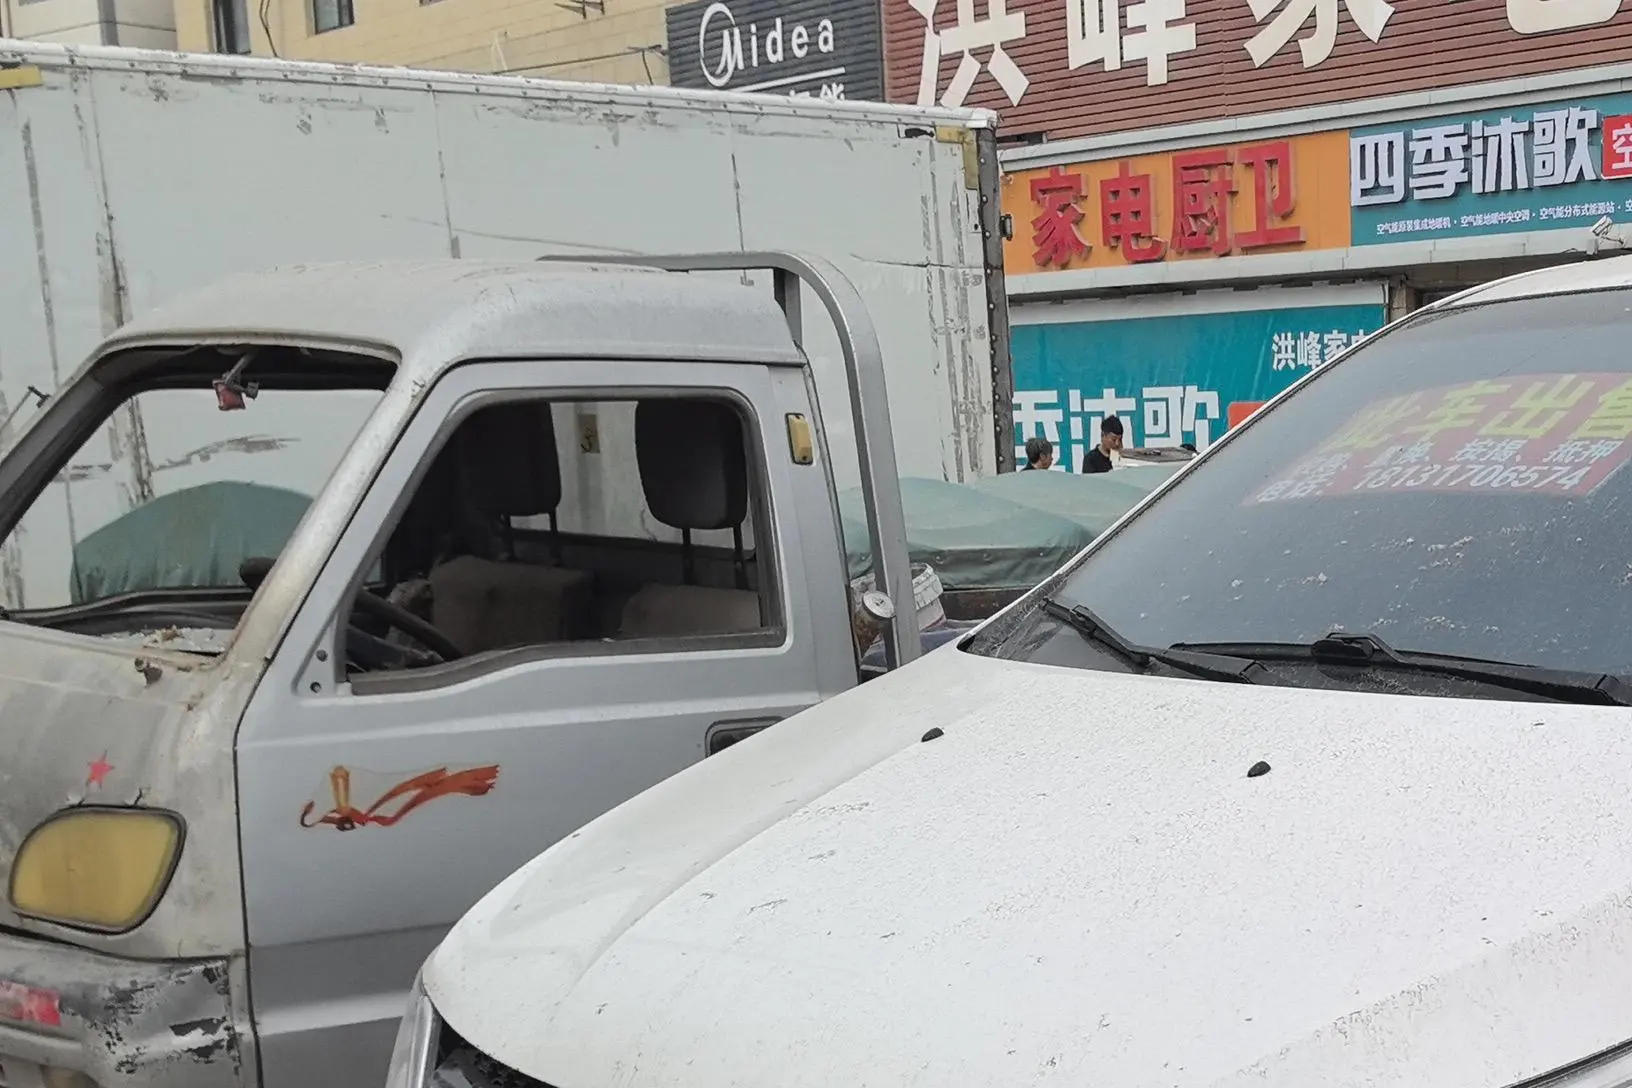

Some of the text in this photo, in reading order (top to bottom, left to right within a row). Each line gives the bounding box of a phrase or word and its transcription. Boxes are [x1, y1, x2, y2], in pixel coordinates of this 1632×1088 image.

[699, 2, 835, 87] Midea
[1029, 140, 1306, 269] 家电厨卫
[1350, 106, 1599, 207] 四季沐歌
